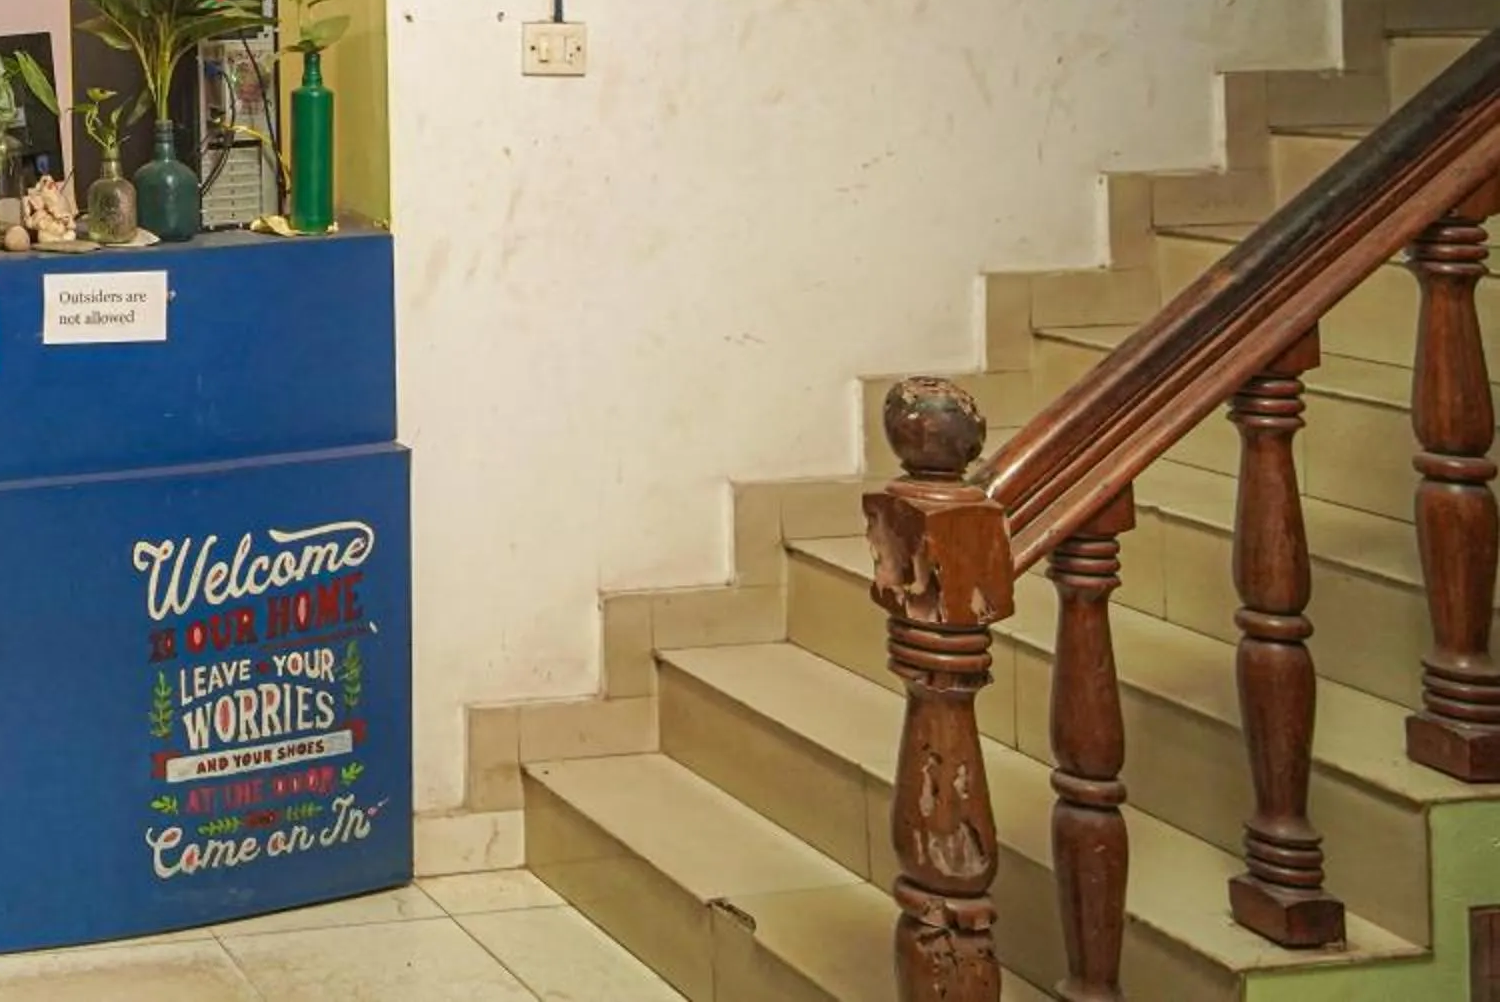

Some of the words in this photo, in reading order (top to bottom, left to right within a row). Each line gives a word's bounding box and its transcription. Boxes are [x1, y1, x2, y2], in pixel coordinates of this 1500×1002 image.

[59, 313, 80, 324] not
[84, 309, 135, 324] allowed
[60, 289, 123, 304] Outsiders
[125, 292, 147, 302] are
[132, 521, 375, 621] Welcome
[185, 606, 258, 653] OUR
[266, 572, 364, 640] HOME
[179, 658, 252, 706] LEAVE
[272, 648, 335, 683] YOUR
[182, 682, 335, 750] WORRIES
[196, 757, 229, 775] AND
[232, 750, 273, 768] YOUR
[277, 740, 326, 761] SHOES
[146, 826, 261, 879] Come
[267, 825, 315, 856] on
[320, 794, 371, 847] In
